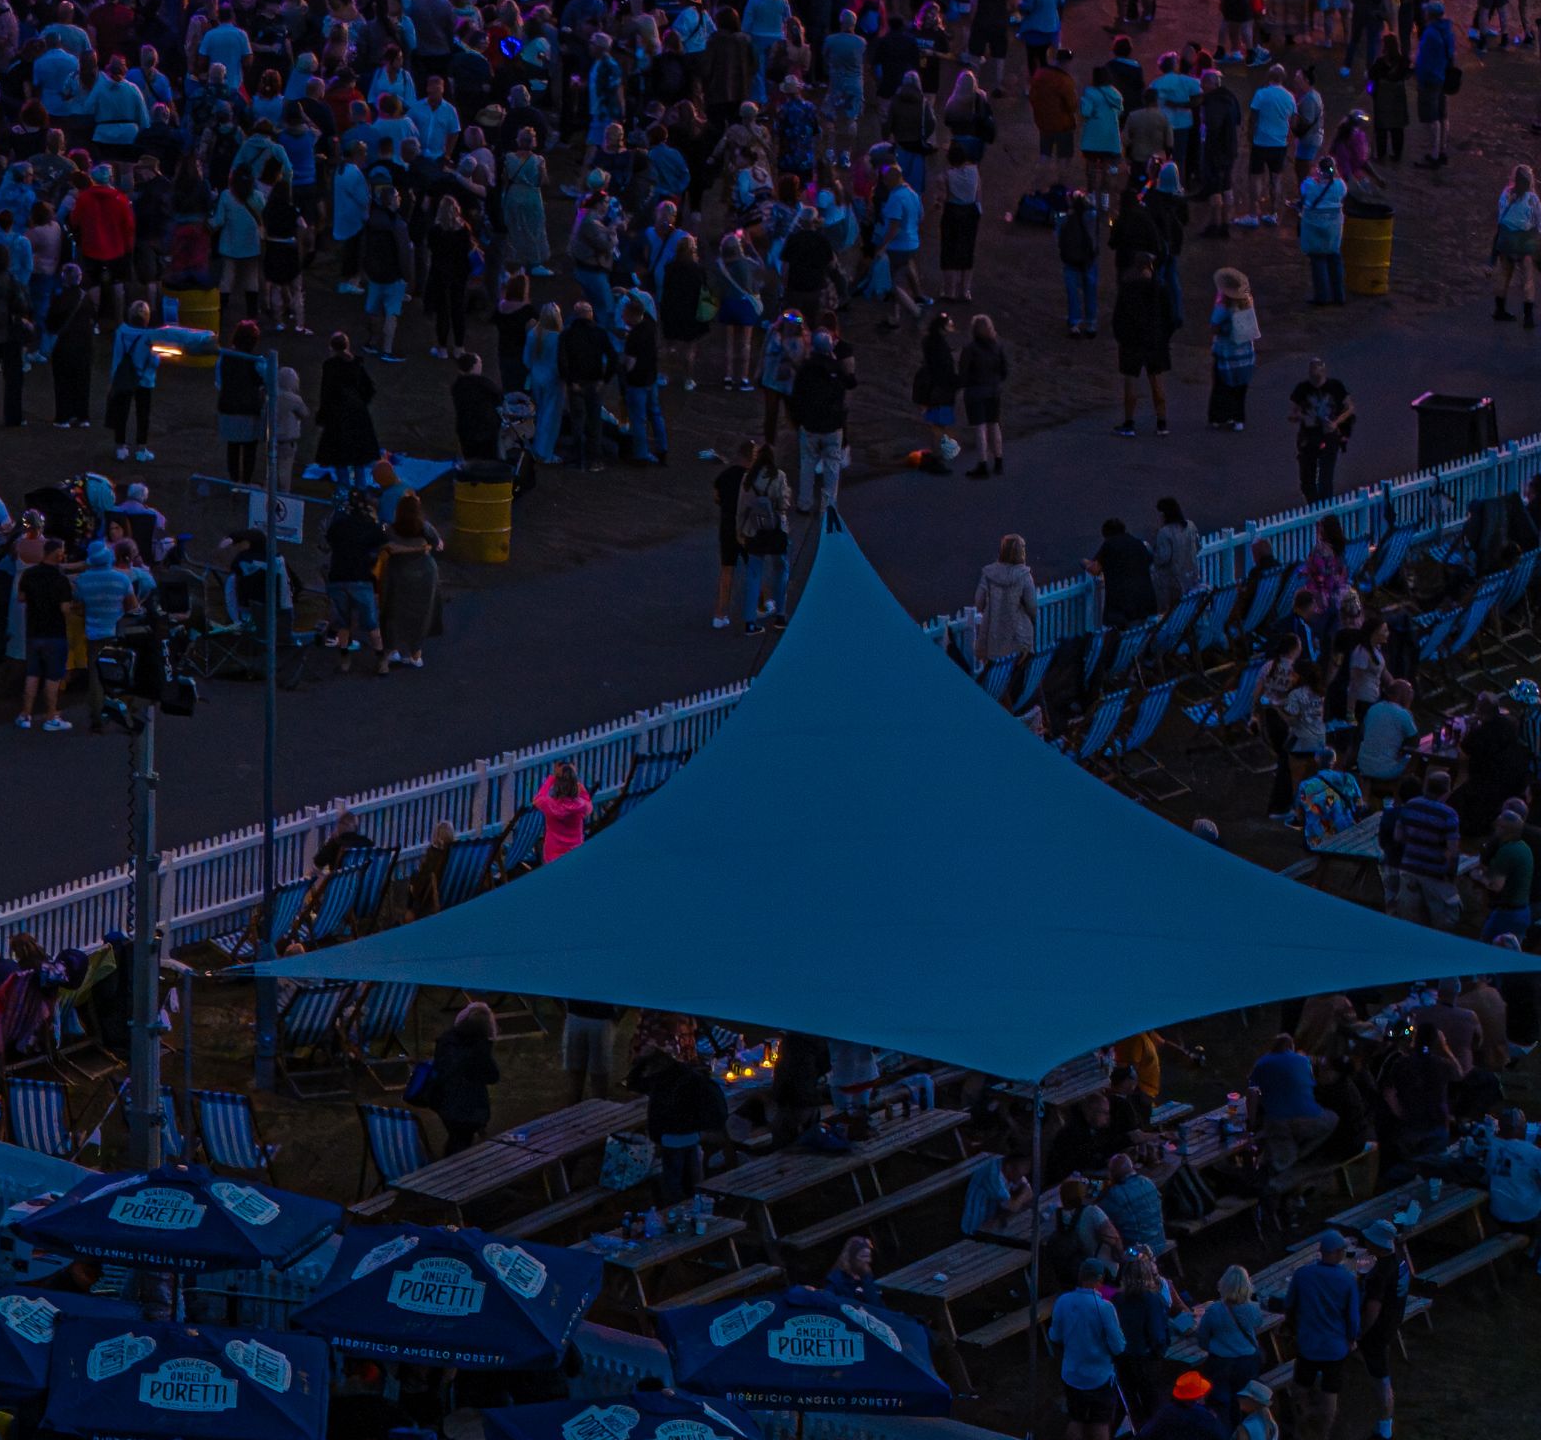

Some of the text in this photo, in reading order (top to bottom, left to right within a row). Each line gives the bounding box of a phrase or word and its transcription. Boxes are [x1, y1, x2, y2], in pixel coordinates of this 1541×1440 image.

[122, 1202, 195, 1222] PORETTI
[399, 1281, 477, 1308] PORETTI
[779, 1337, 855, 1357] PORETTI
[150, 1382, 228, 1404] PORETTI
